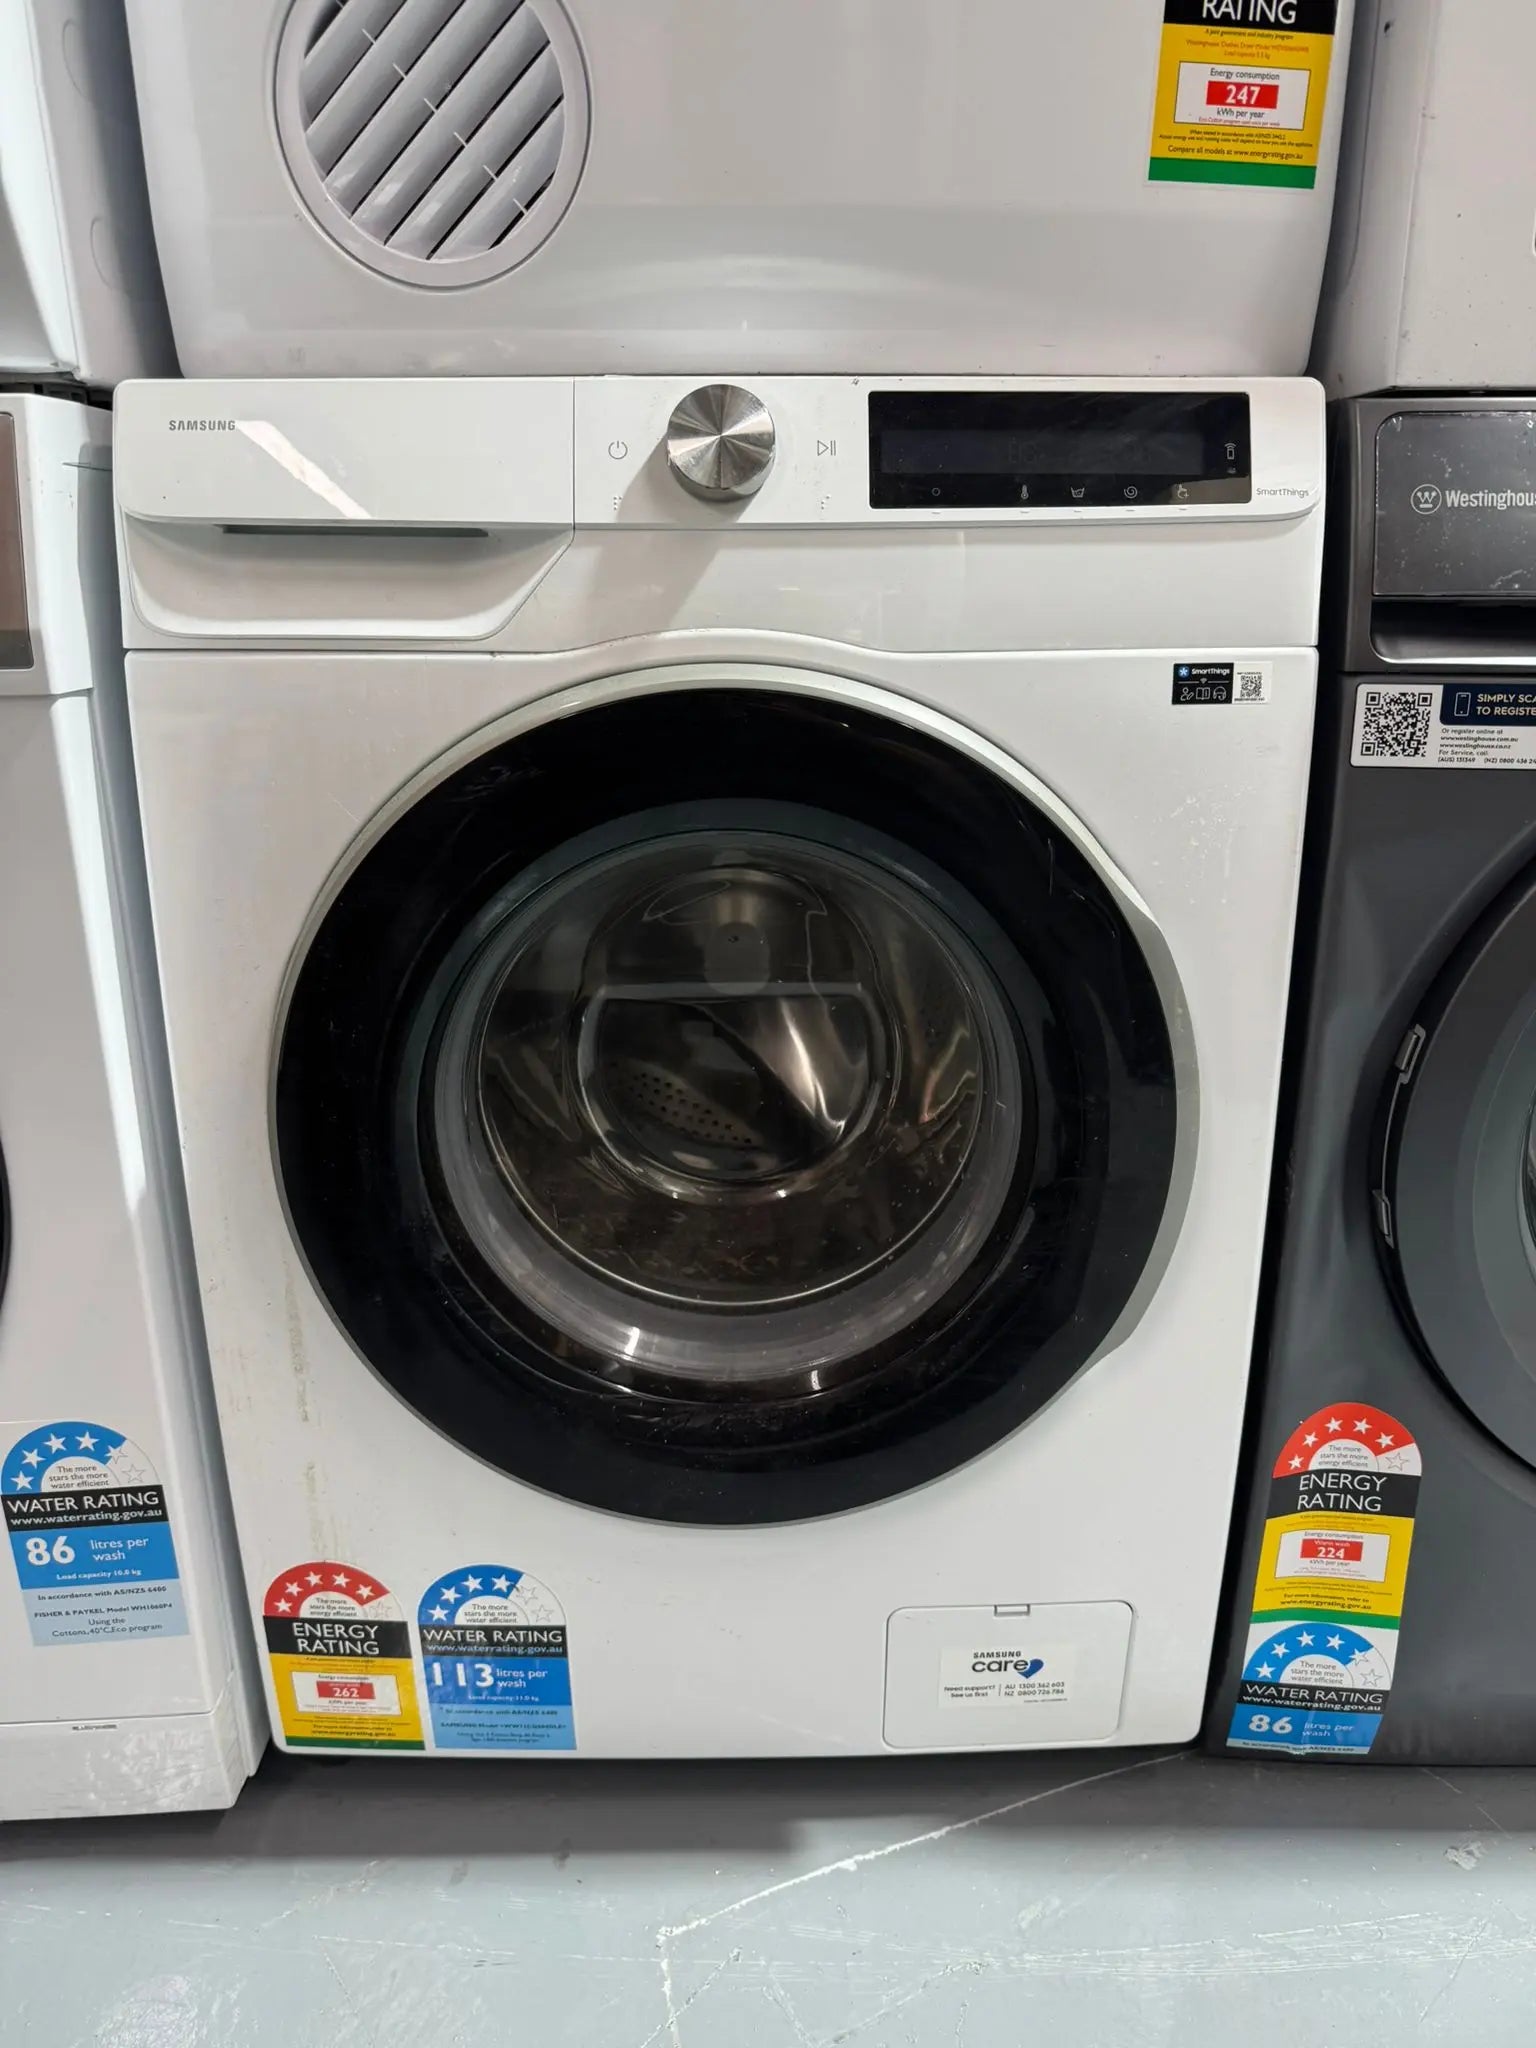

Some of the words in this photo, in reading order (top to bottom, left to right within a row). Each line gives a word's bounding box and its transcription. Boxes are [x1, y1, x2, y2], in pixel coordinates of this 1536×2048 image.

[1210, 68, 1232, 79] Energy
[1236, 72, 1279, 82] consumption
[1225, 85, 1260, 105] 247
[1217, 108, 1234, 117] kWh
[1236, 110, 1247, 119] per
[1250, 111, 1265, 119] year
[169, 420, 236, 431] SAMSUNG
[1257, 488, 1309, 498] SmartThings
[1477, 694, 1515, 702] SIMPLY
[1476, 707, 1491, 715] TO
[77, 1480, 109, 1488] efficient
[1300, 1473, 1387, 1491] ENERGY
[8, 1496, 80, 1513] WATER
[83, 1491, 159, 1510] RATING
[1298, 1493, 1382, 1511] RATING
[11, 1510, 162, 1526] www.waterrating.gov.au
[26, 1536, 75, 1566] 86
[91, 1539, 123, 1550] litres
[127, 1538, 148, 1549] per
[93, 1551, 125, 1561] wash
[1317, 1547, 1345, 1558] 224
[73, 1608, 104, 1616] PAYKEL
[129, 1624, 162, 1633] program
[293, 1623, 379, 1639] ENERGY
[423, 1630, 487, 1642] WATER
[493, 1630, 562, 1642] RATING
[297, 1639, 379, 1655] RATING
[427, 1644, 563, 1654] www.waterrating.gov.au
[972, 1659, 1029, 1672] care
[1301, 1661, 1314, 1669] The
[433, 1663, 494, 1687] 113
[496, 1668, 525, 1677] litres
[528, 1670, 548, 1679] per
[497, 1679, 526, 1688] wash
[1315, 1677, 1343, 1685] efficient
[333, 1688, 359, 1697] 262
[1246, 1684, 1309, 1699] WATER
[1315, 1690, 1383, 1703] RATING
[1243, 1695, 1381, 1711] www.waterrating.gov.au
[1249, 1714, 1292, 1734] 86
[1305, 1722, 1331, 1730] litres
